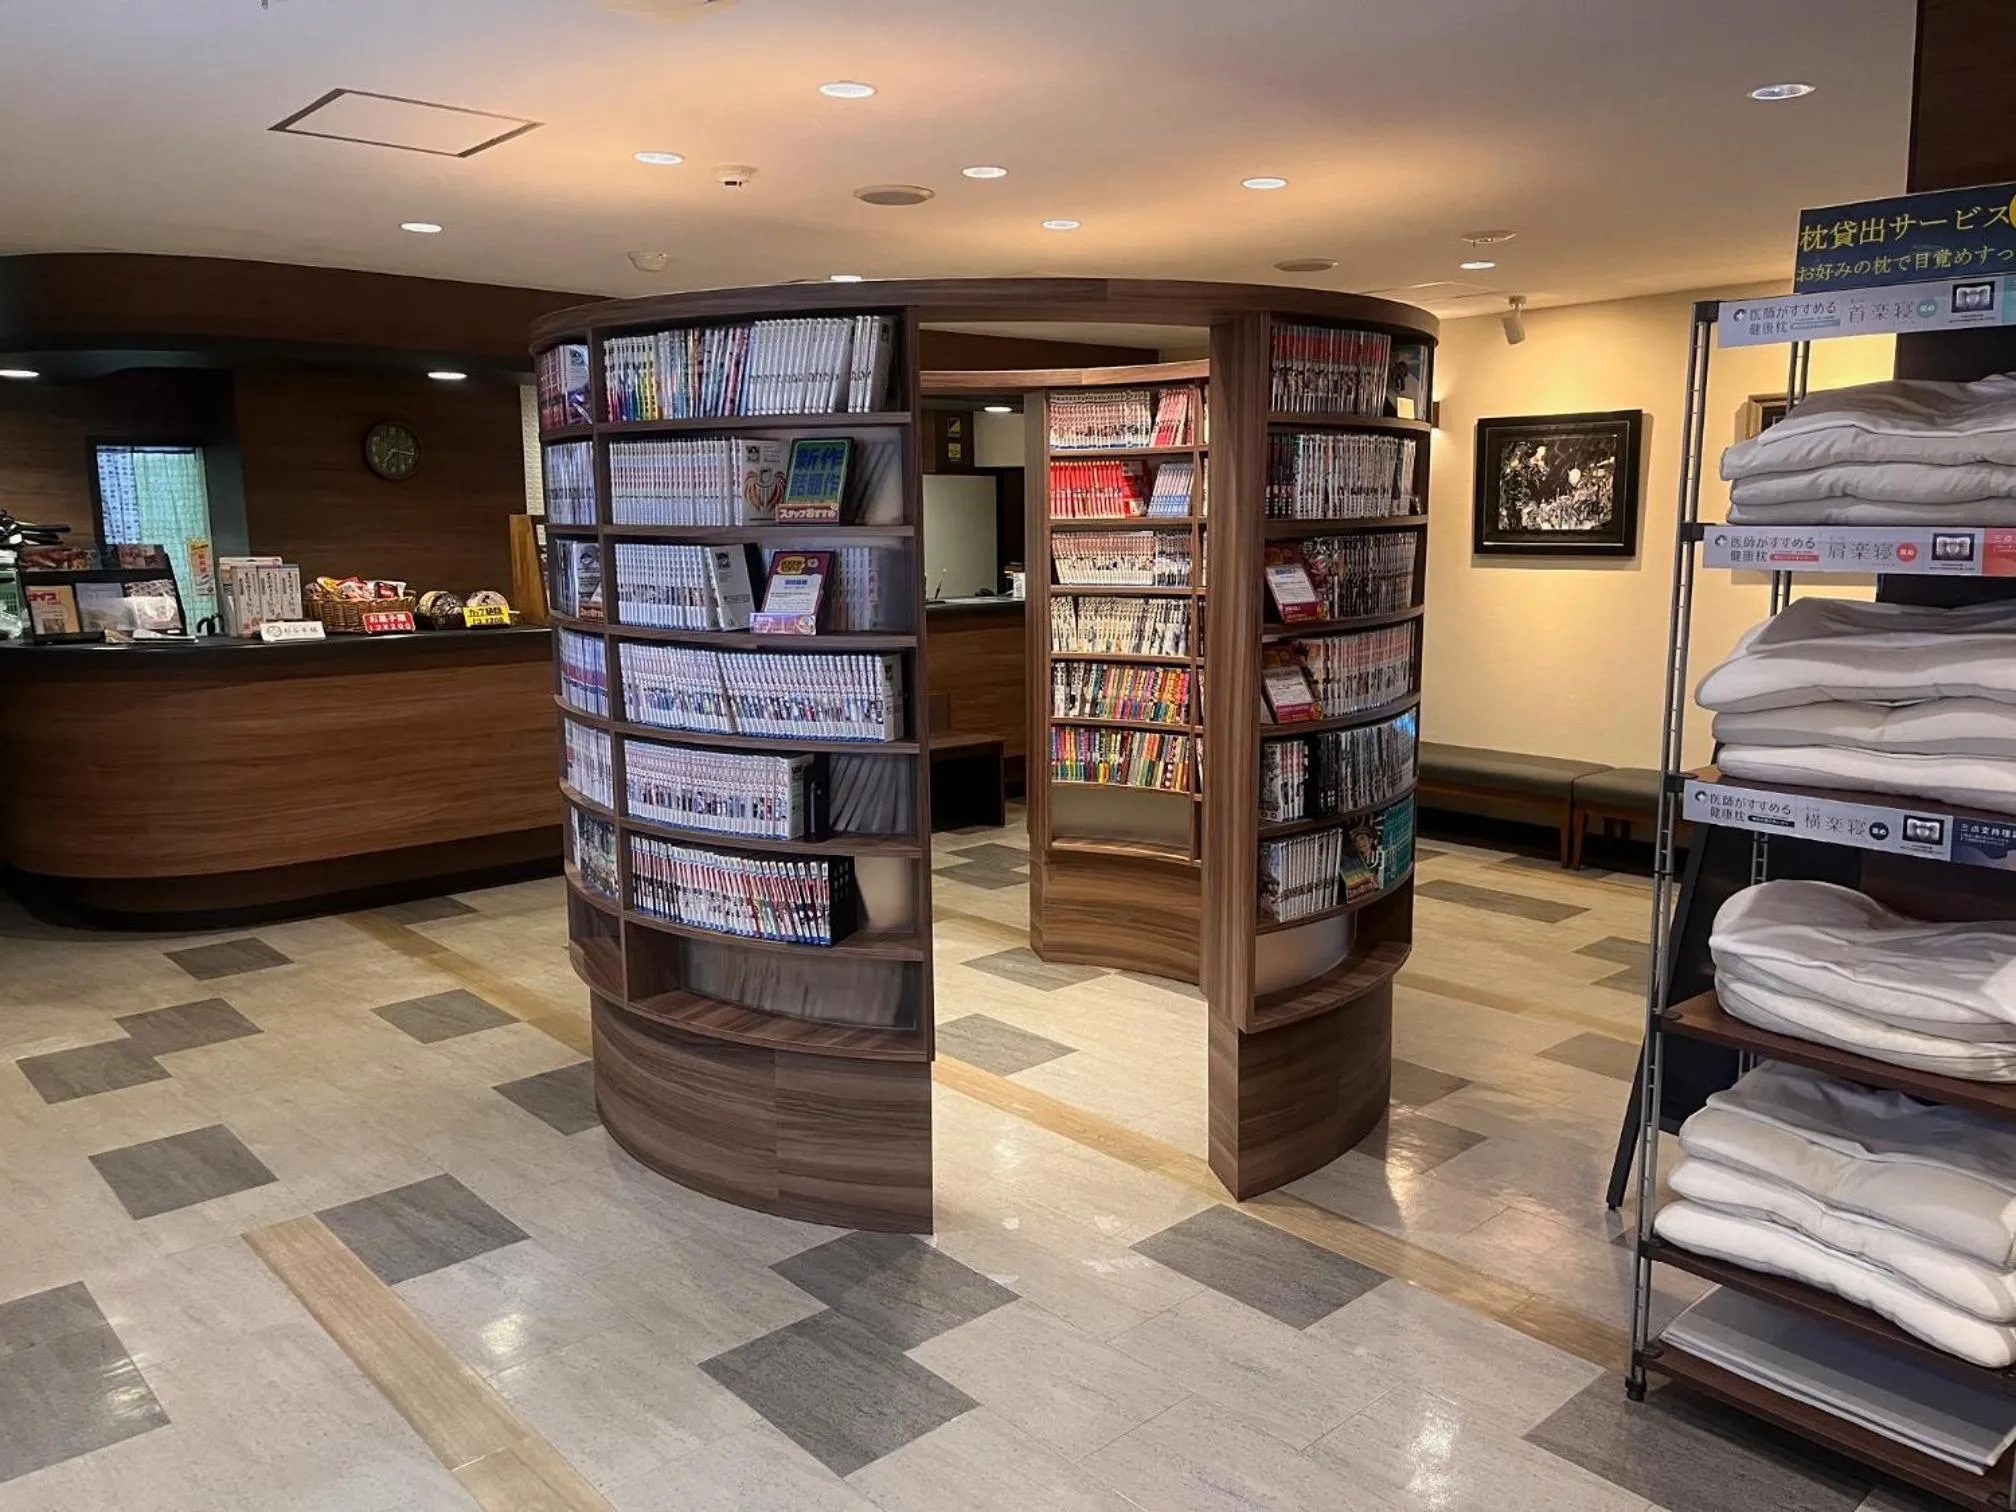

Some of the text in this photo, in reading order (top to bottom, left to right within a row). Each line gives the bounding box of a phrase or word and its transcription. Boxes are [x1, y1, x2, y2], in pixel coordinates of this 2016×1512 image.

[1800, 206, 2010, 252] 枕貸出サービス
[1796, 245, 2014, 282] お好みの枕で目覚めすっ
[1749, 301, 1837, 322] 医師がすすめる
[1749, 321, 1788, 336] 健康枕
[1729, 536, 1816, 549] 医師がすすめる
[1729, 550, 1768, 562] 健康枕
[1709, 792, 1792, 816] 医師がすすめる
[1709, 806, 1746, 823] 健康枕
